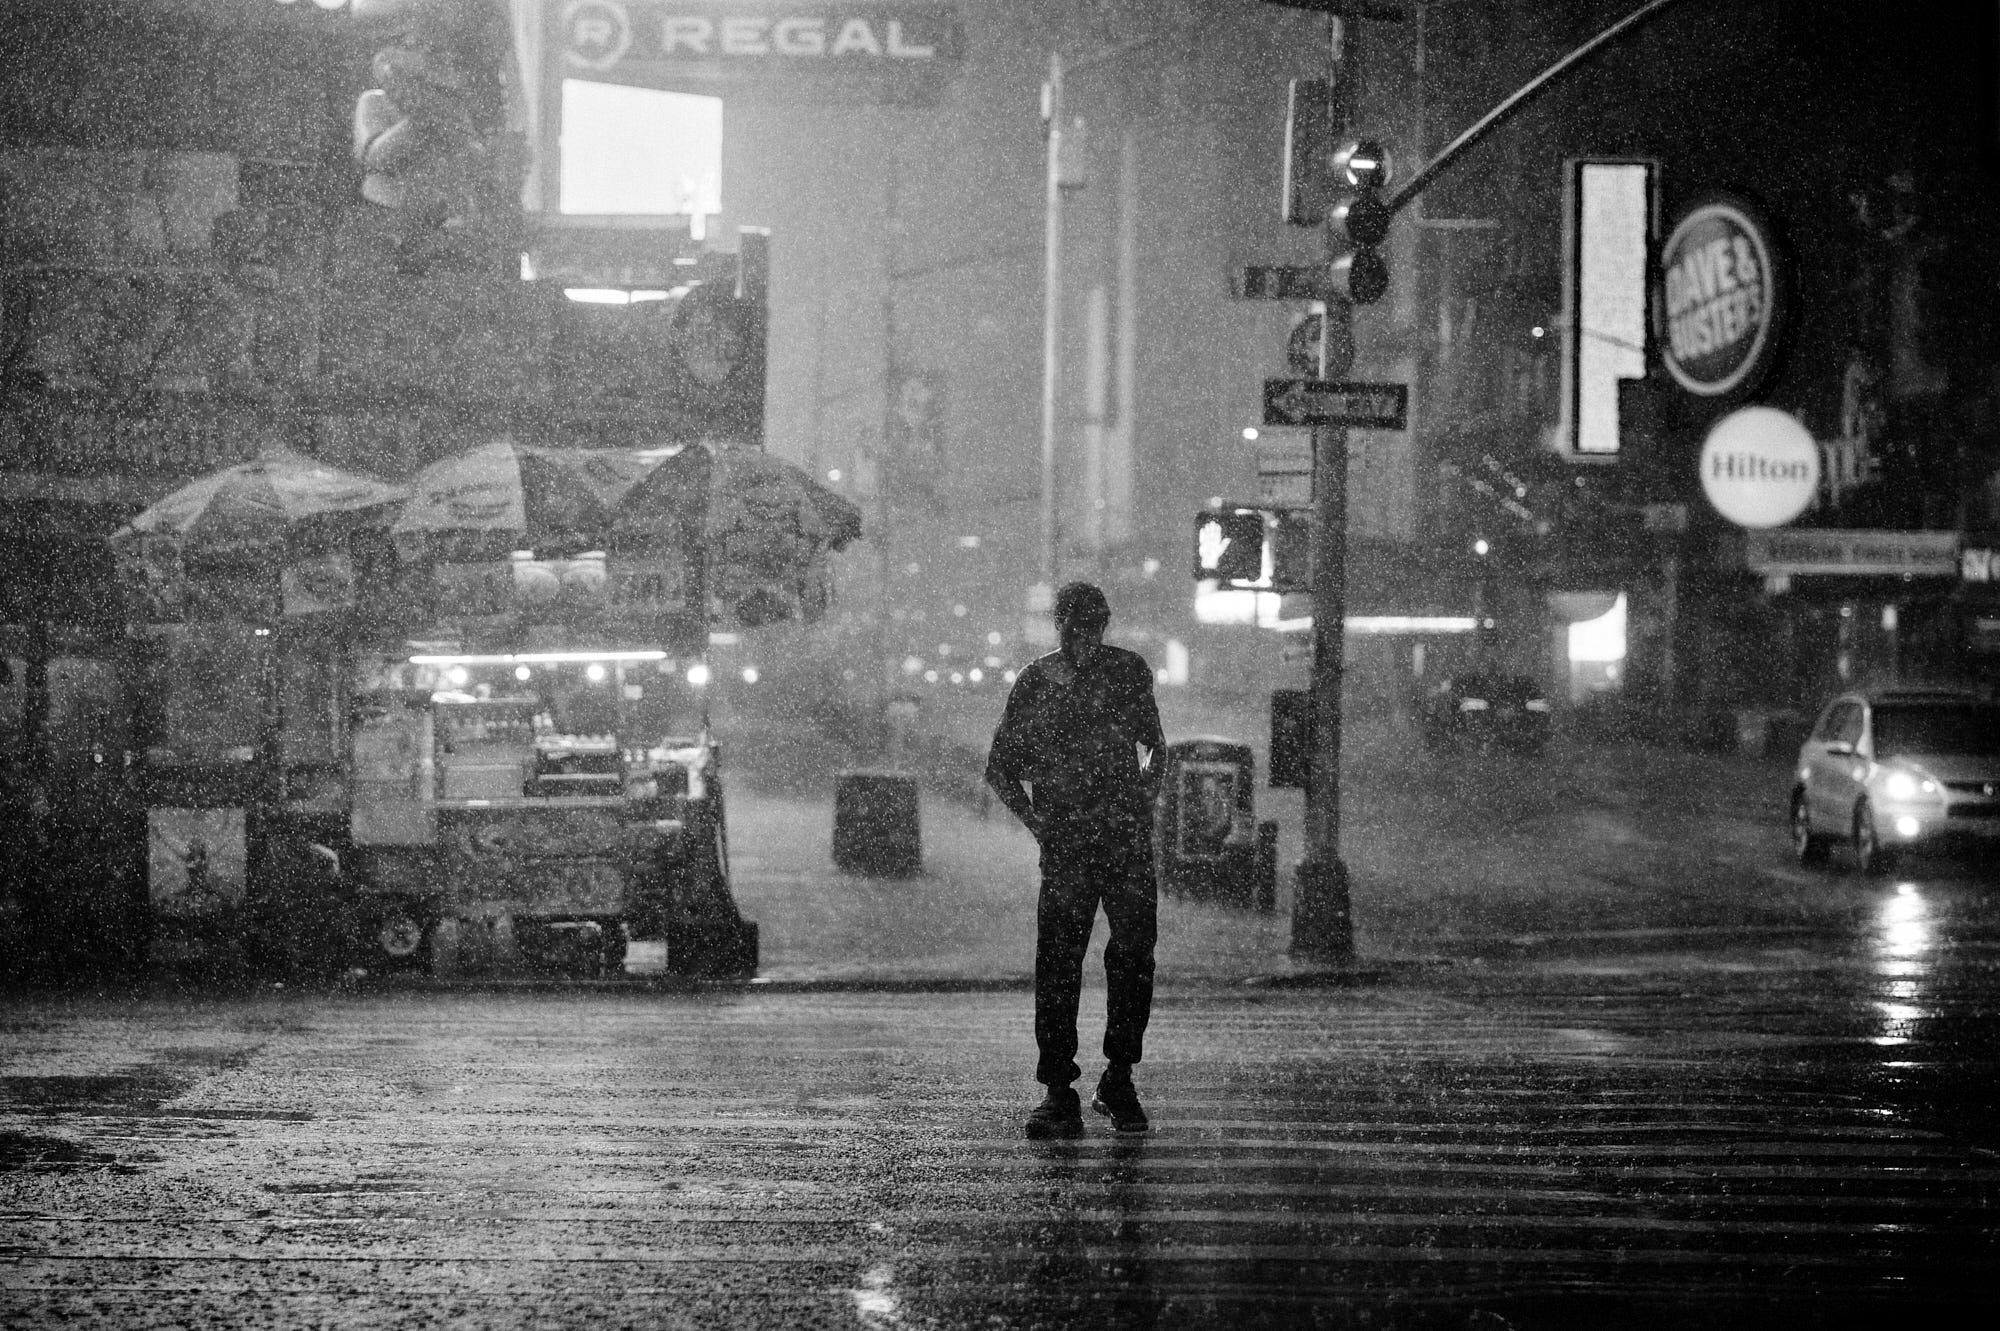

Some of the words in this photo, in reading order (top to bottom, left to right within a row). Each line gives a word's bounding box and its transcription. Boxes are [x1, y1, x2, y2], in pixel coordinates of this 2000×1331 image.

[661, 16, 934, 57] REGAL
[1666, 237, 1737, 318] DAVE
[1712, 451, 1809, 482] Hilton
